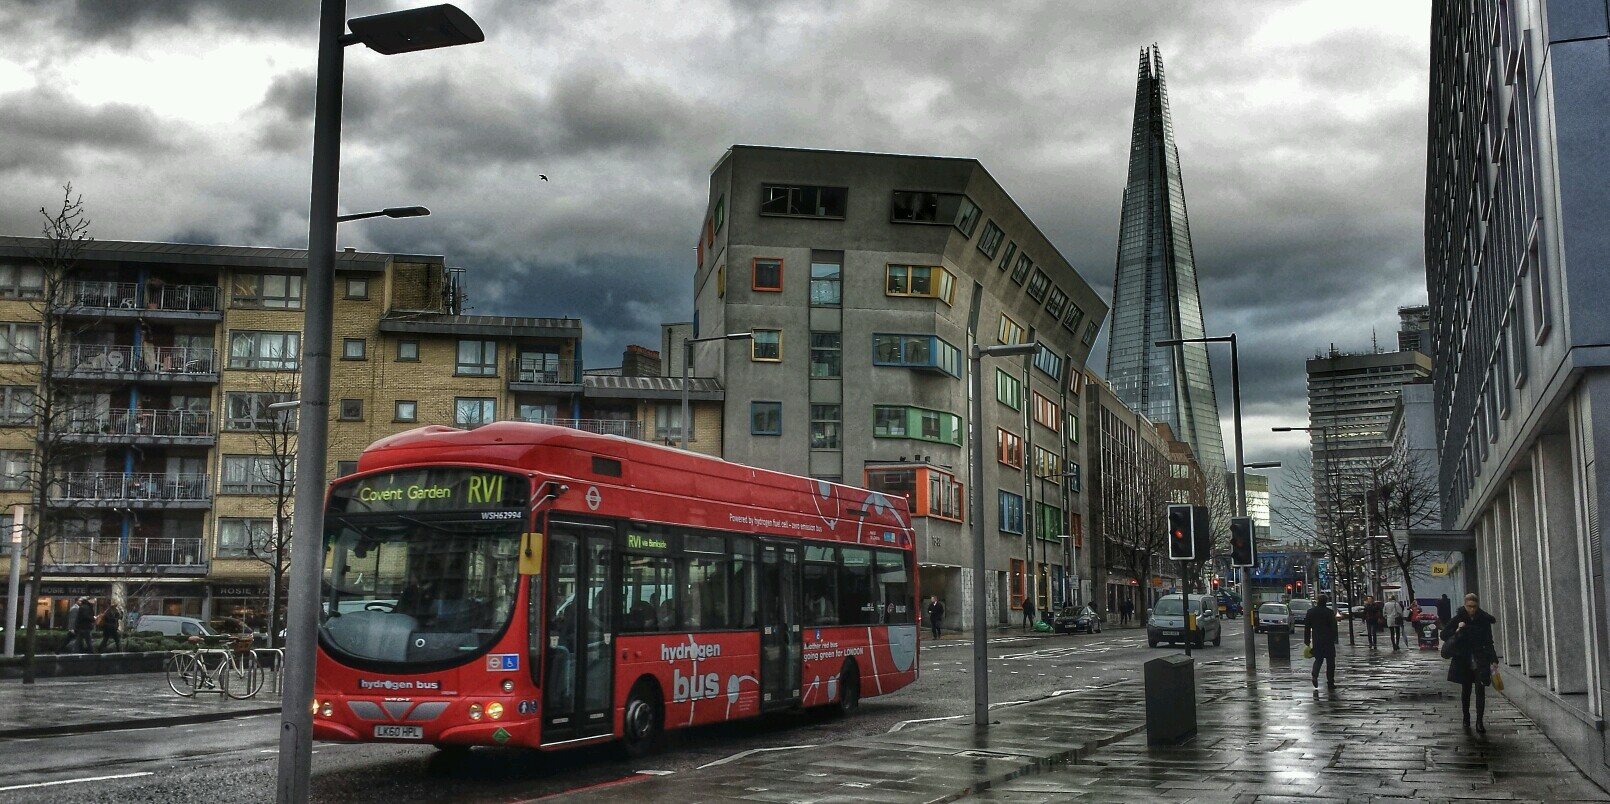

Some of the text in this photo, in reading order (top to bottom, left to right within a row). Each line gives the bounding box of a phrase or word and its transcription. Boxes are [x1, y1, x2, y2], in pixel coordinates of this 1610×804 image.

[360, 485, 451, 501] Covent Garden
[481, 511, 522, 520] WSH62994
[729, 512, 748, 524] Powered
[754, 517, 773, 528] hydrogen
[1433, 566, 1444, 574] itsu
[822, 641, 830, 649] red
[803, 652, 819, 662] going
[820, 651, 835, 661] green
[844, 647, 864, 657] LONDON
[661, 642, 721, 703] hydrogen bus
[361, 679, 439, 691] hydrogen bus
[377, 726, 419, 738] LK60 HPL
